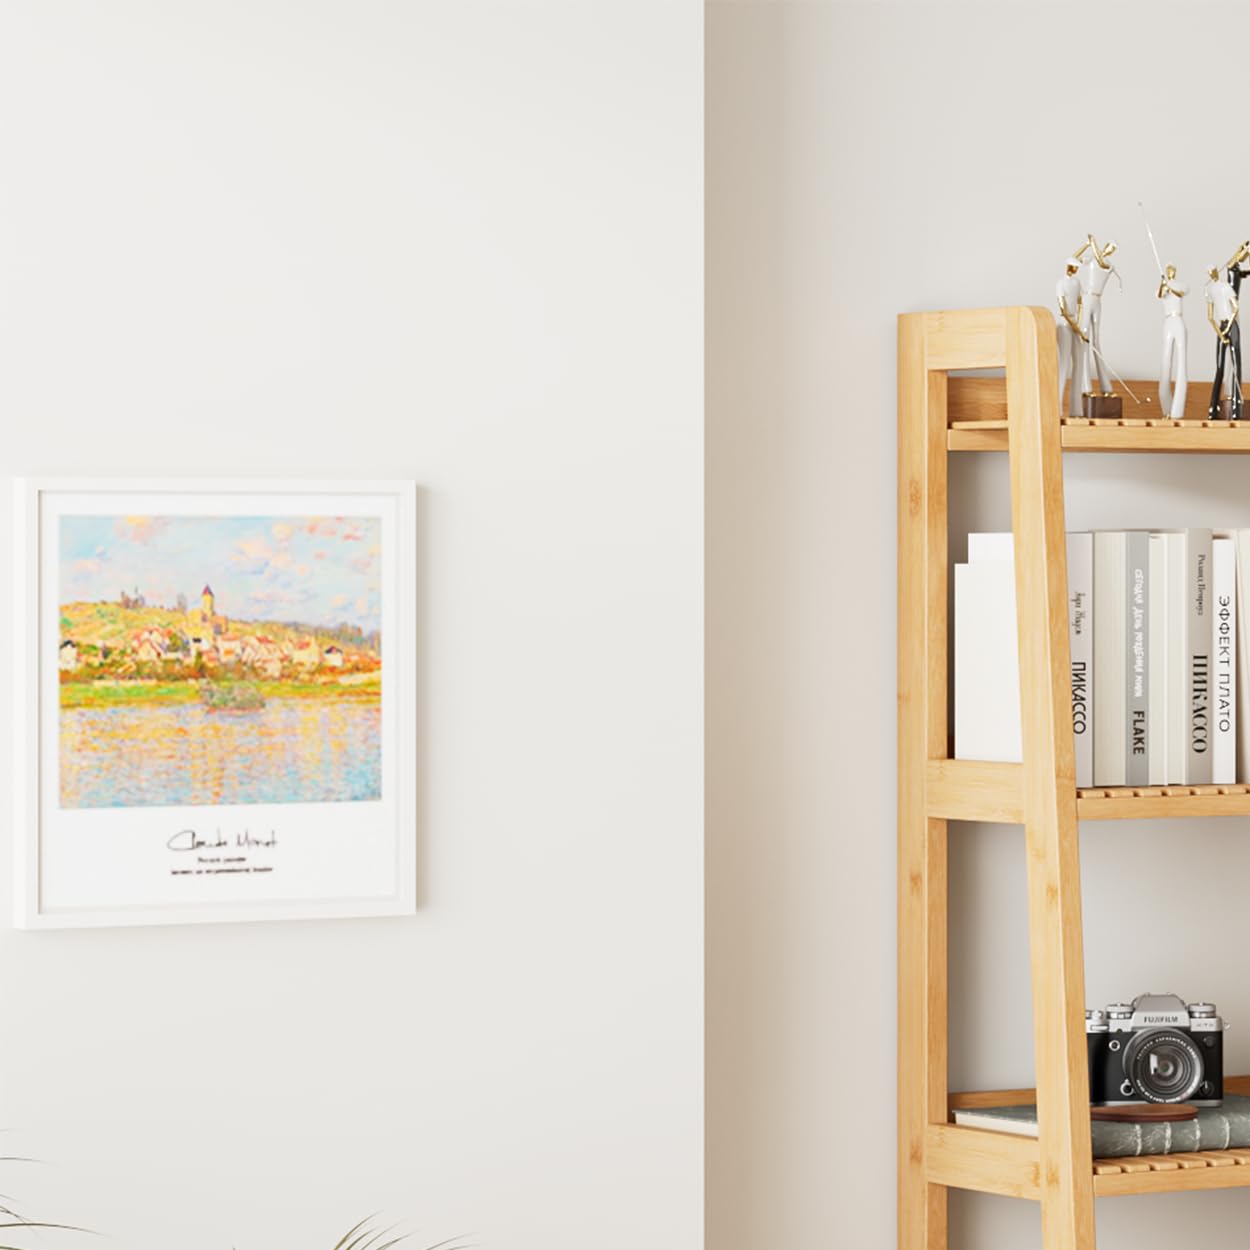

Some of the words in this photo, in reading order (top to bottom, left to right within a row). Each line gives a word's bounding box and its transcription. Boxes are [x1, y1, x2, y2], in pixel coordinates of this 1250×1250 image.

[1219, 595, 1230, 666] ЭФФЕКТ
[1072, 662, 1086, 735] ПИКАССО
[1133, 711, 1145, 755] FLAKE
[1192, 655, 1208, 754] ПИКАССО
[1219, 673, 1230, 733] ПЛАТО
